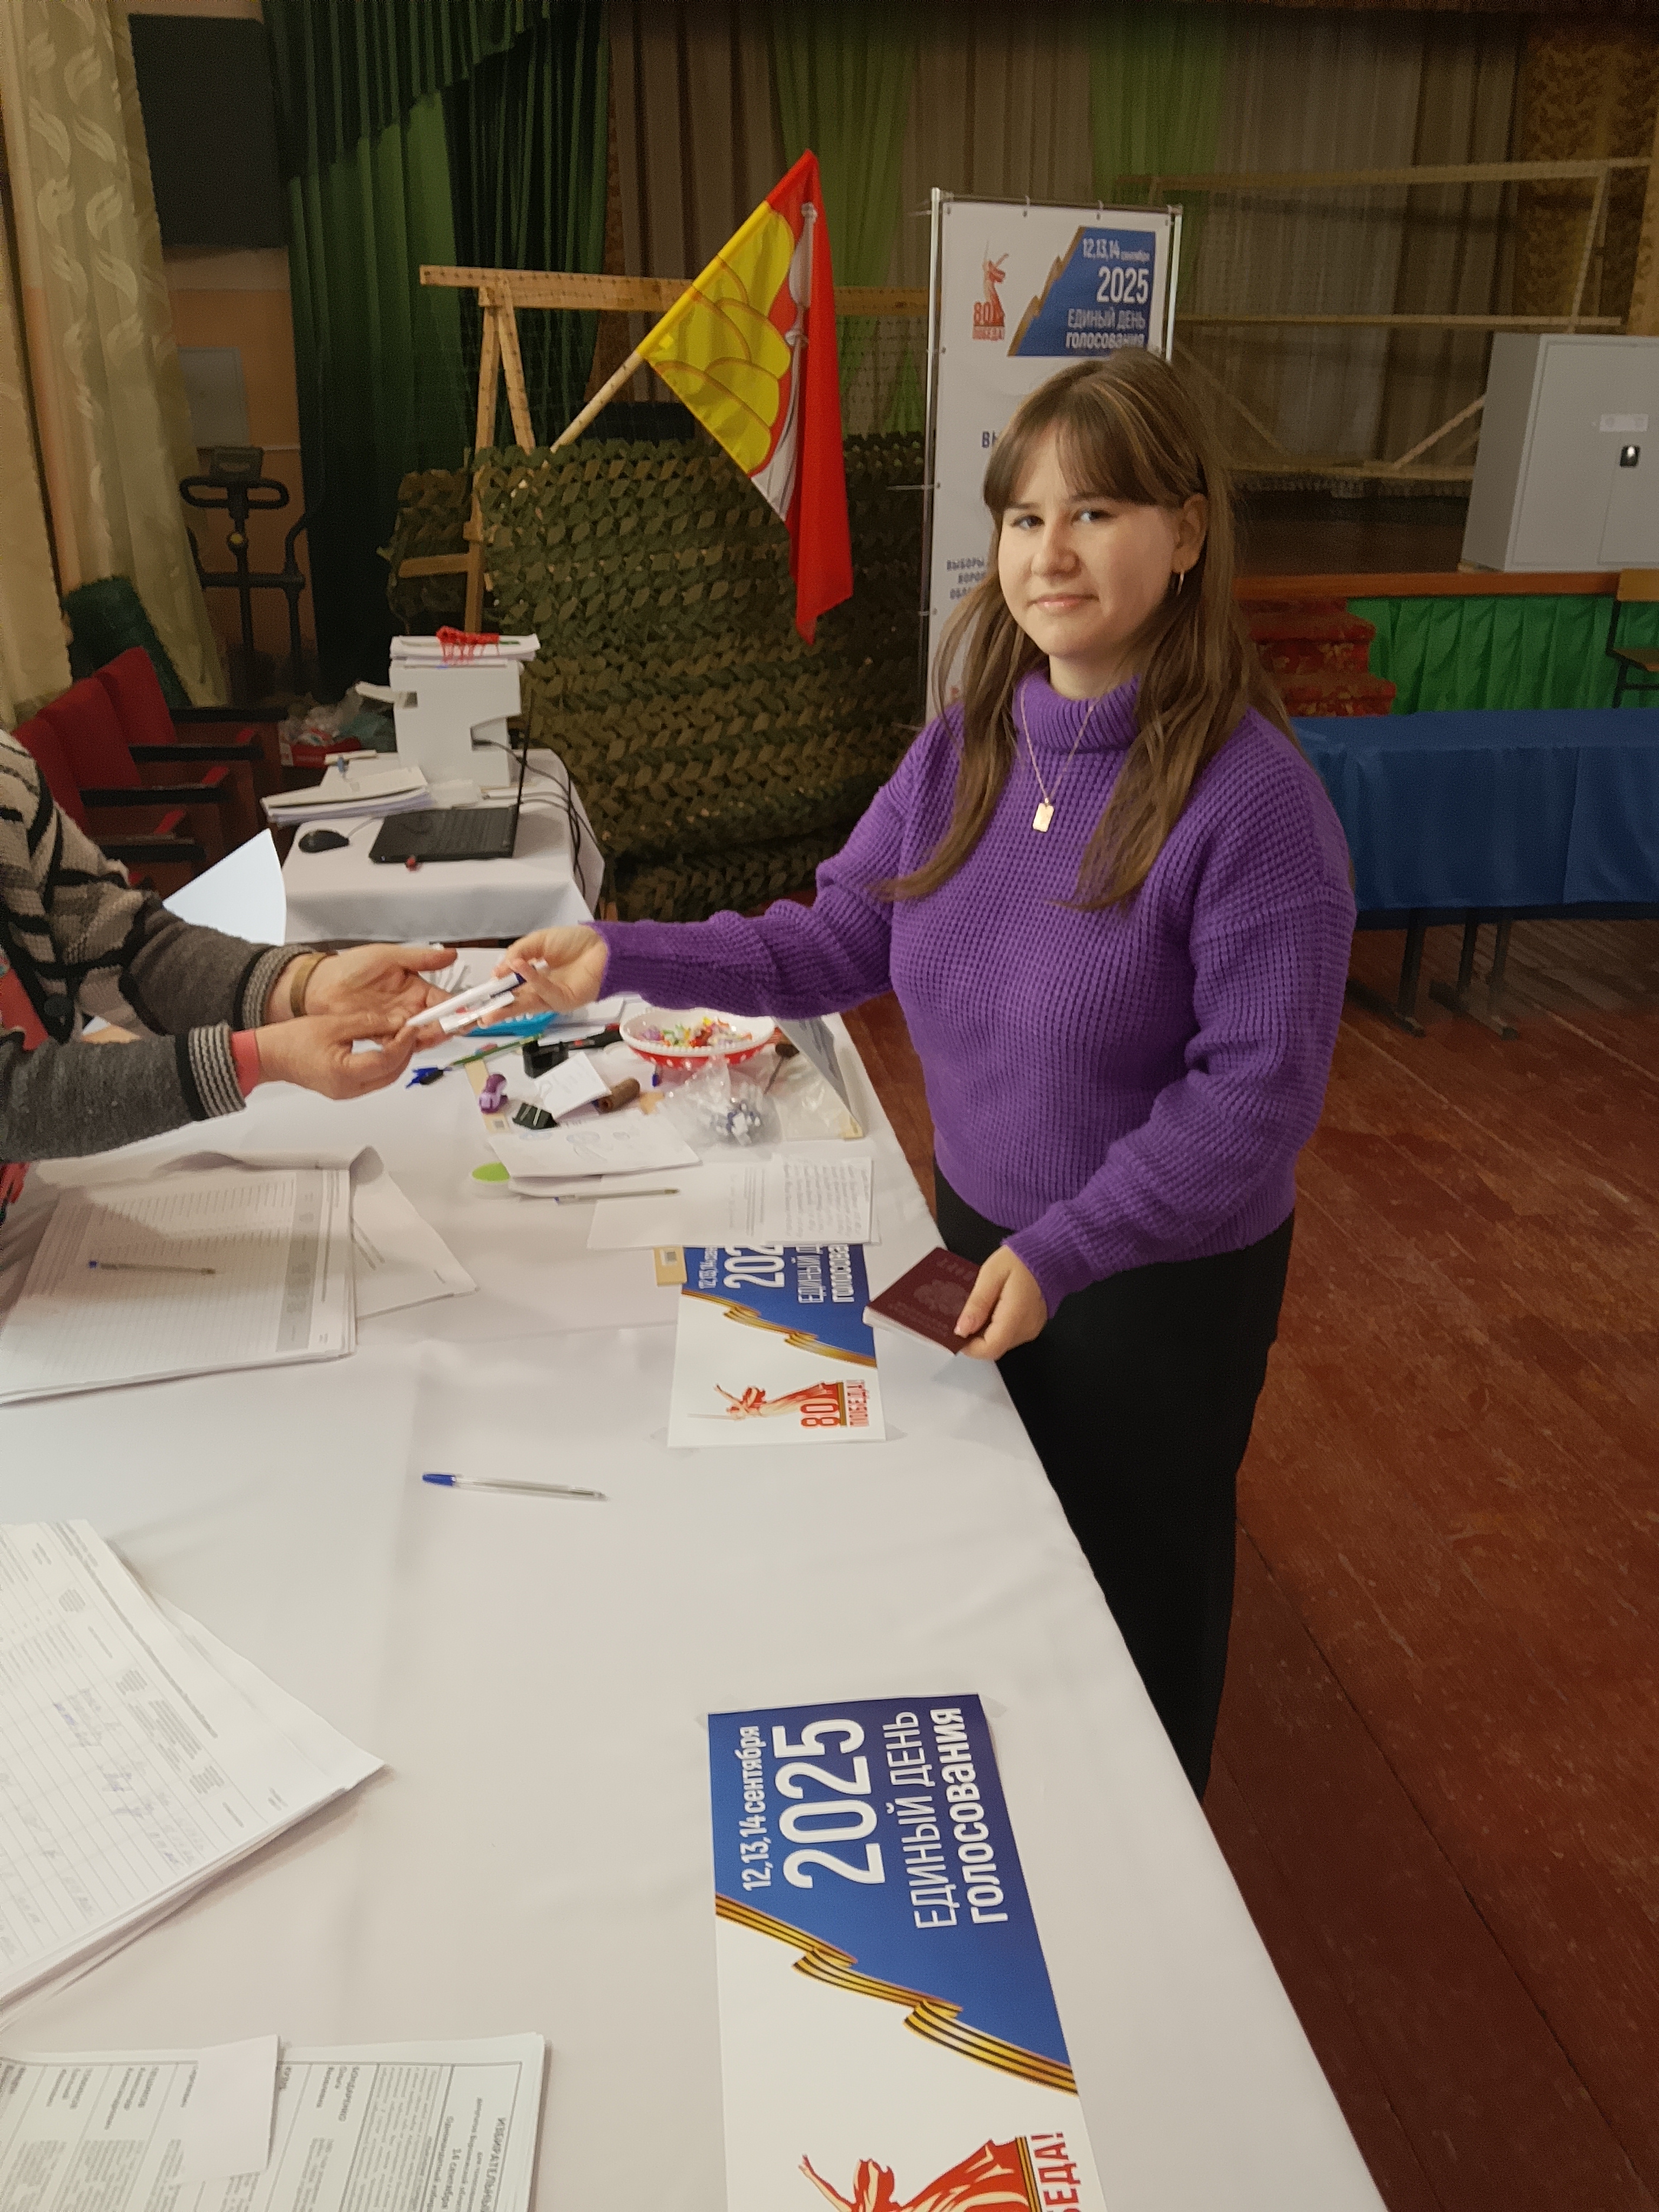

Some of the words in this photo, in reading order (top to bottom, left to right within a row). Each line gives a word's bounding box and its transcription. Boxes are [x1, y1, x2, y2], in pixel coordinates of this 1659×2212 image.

[1096, 266, 1150, 304] 2025
[1068, 307, 1116, 329] ЕДИНЫЙ
[1116, 310, 1145, 331] ДЕНЬ
[724, 1246, 784, 1289] 202
[791, 1255, 827, 1303] ЕДИНЫЙ
[828, 1245, 855, 1303] голосова
[800, 1403, 840, 1427] 80
[735, 1725, 767, 1813] сентября
[883, 1712, 935, 1787] ДЕНЬ
[772, 1719, 886, 1889] 2025
[930, 1708, 1008, 1924] голосования
[886, 1796, 960, 1928] ЕДИНЫЙ
[1031, 2132, 1081, 2212] ЕДА!
